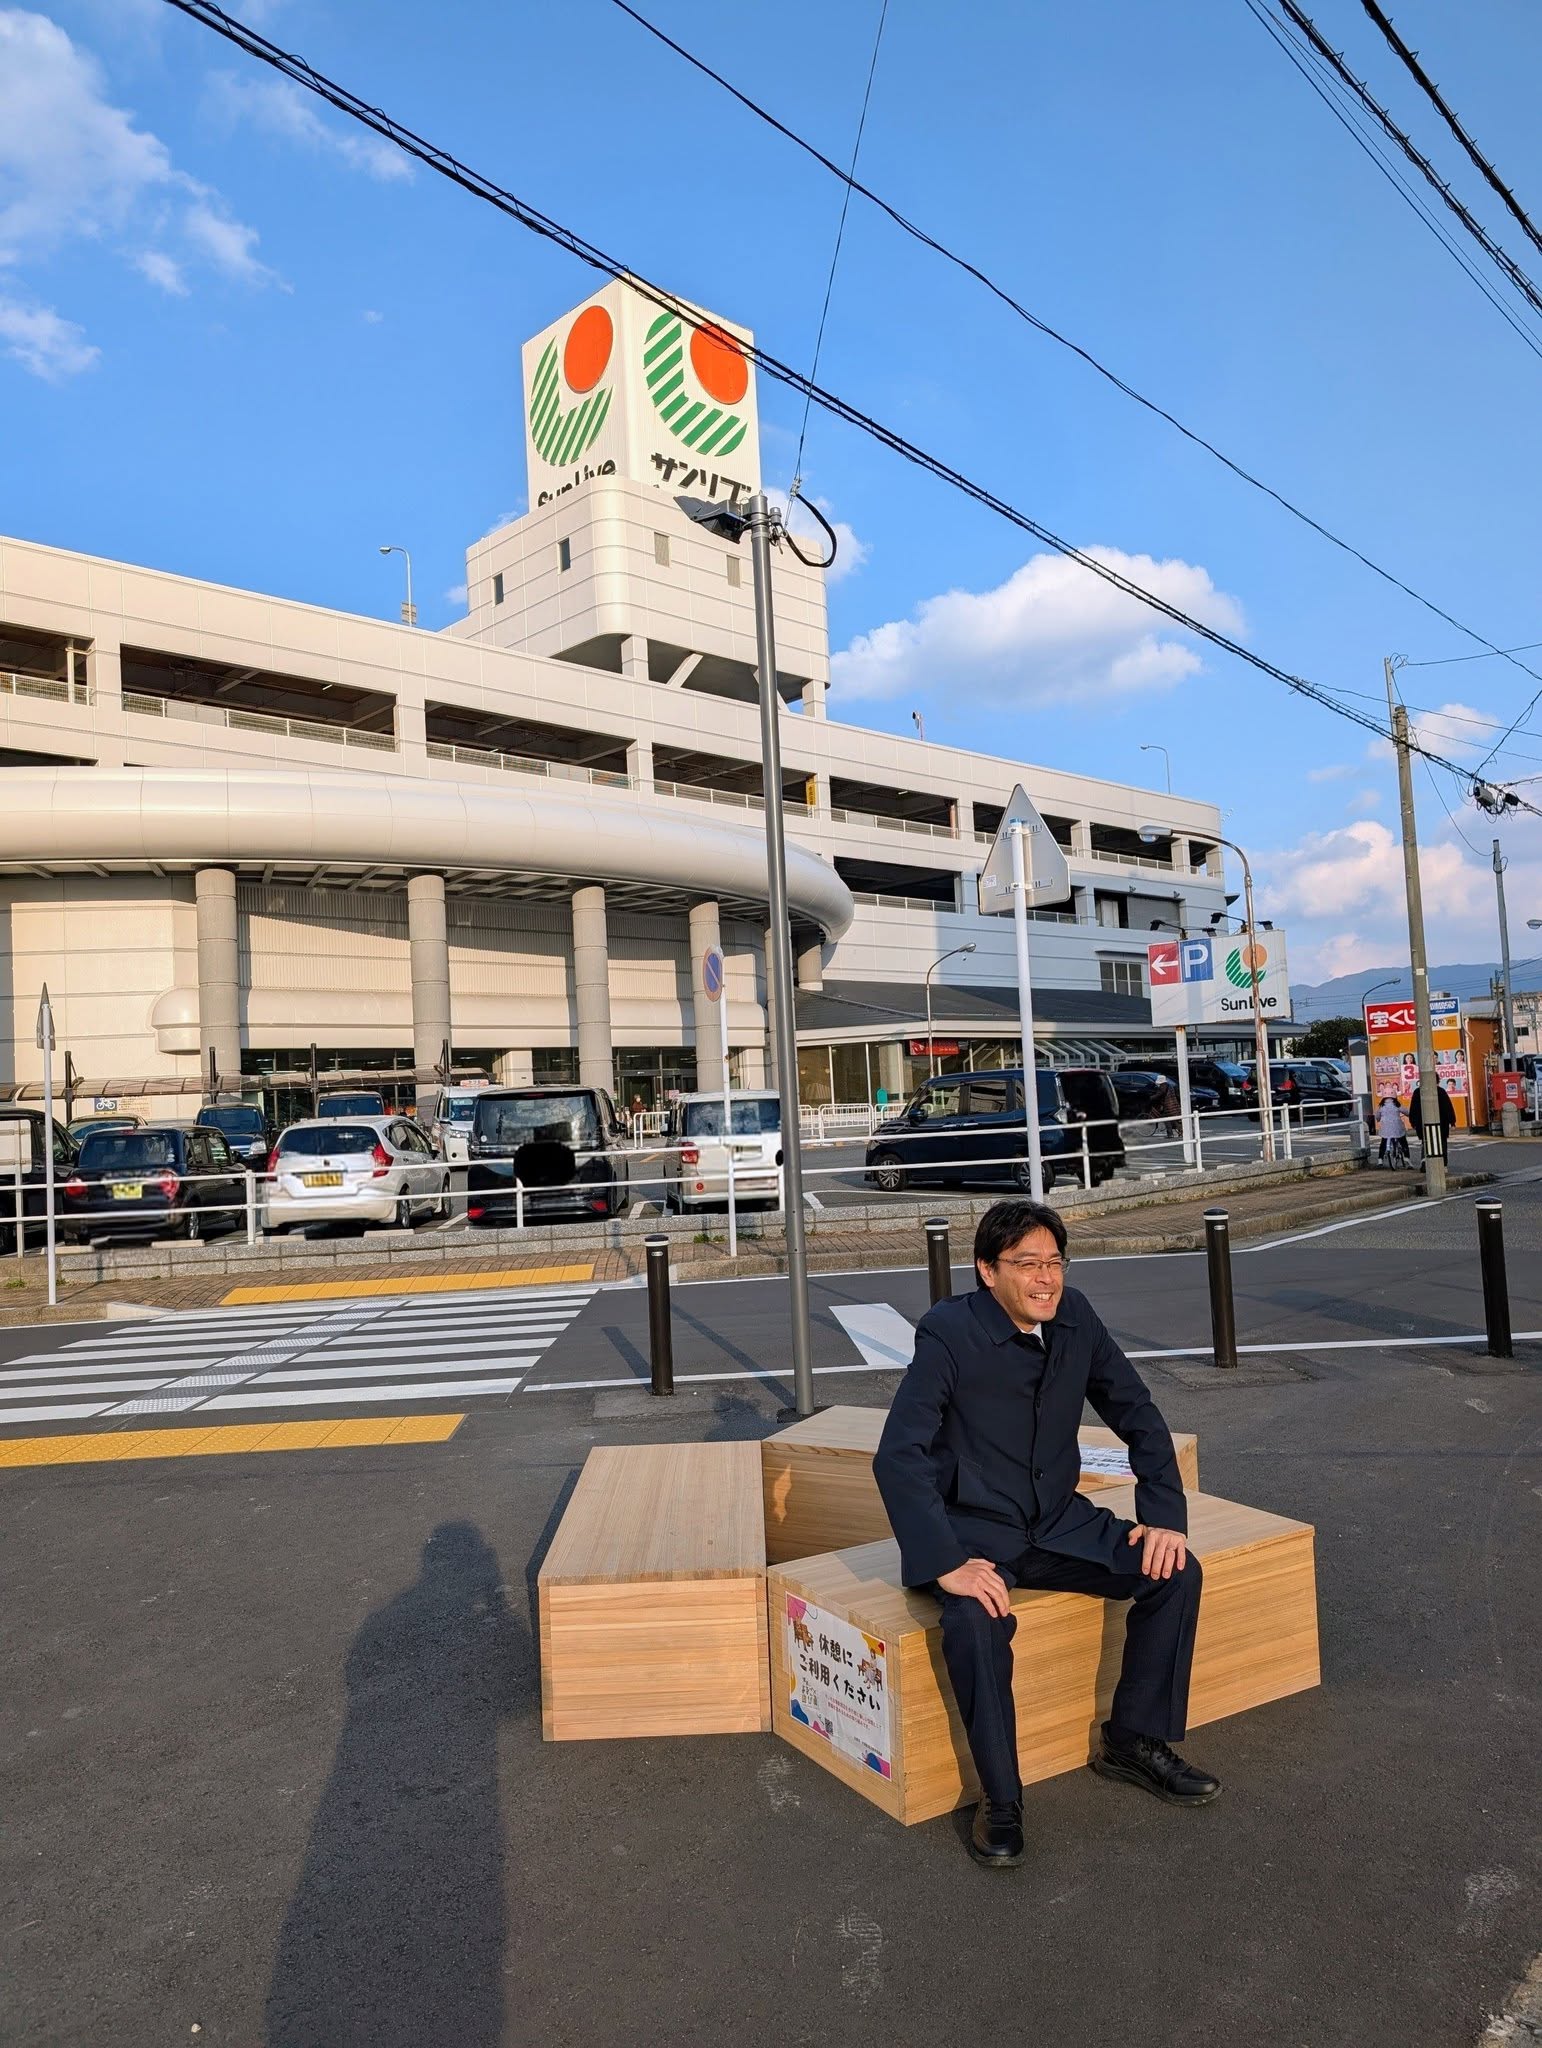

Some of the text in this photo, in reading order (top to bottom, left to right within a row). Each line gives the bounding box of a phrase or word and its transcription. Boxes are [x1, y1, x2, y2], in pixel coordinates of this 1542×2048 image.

[1184, 944, 1209, 978] P
[1221, 996, 1277, 1011] SunLve
[819, 1632, 853, 1668] 休憩に
[799, 1653, 881, 1711] ご利用ください
